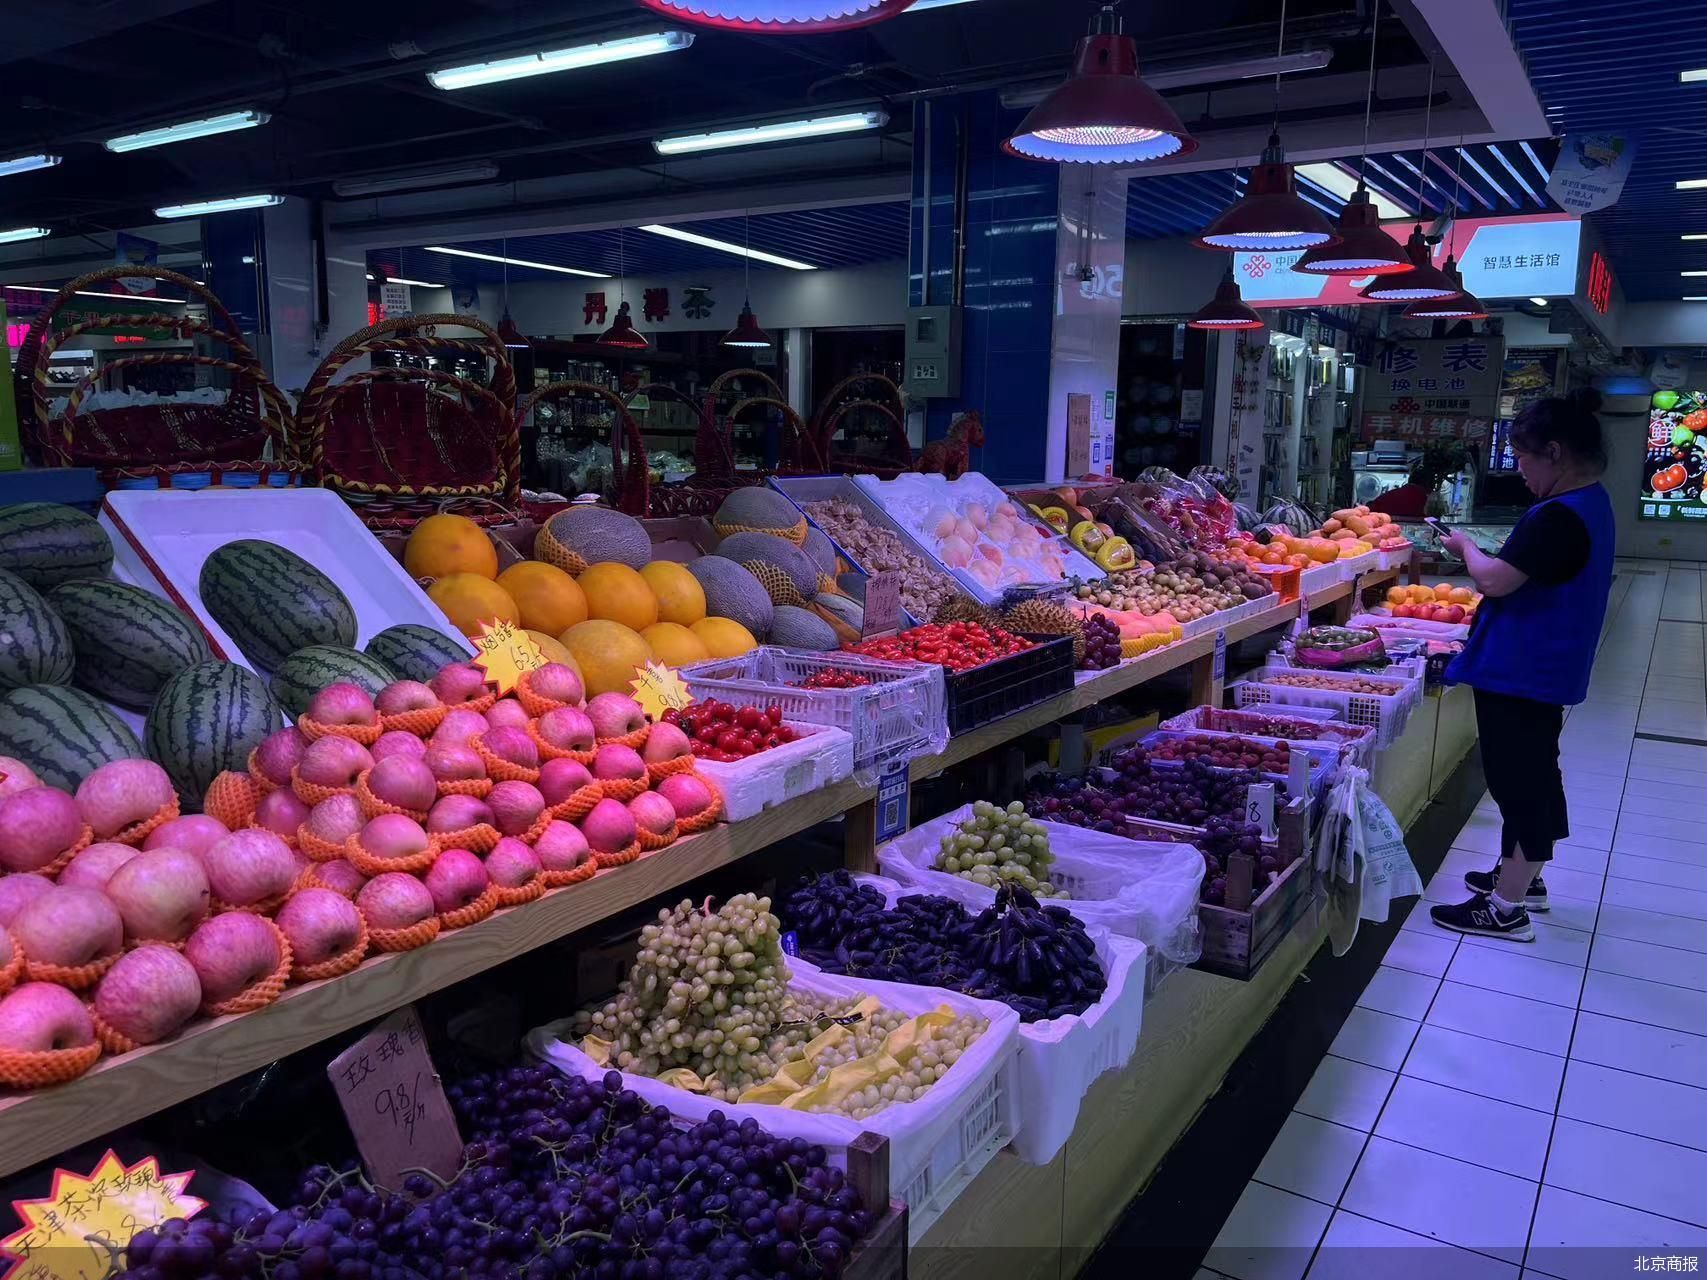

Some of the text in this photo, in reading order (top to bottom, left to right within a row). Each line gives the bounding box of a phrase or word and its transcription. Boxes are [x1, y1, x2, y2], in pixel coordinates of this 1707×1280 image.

[1483, 253, 1560, 270] 智慧生活馆
[1376, 342, 1488, 376] 修表
[1391, 378, 1465, 391] 换电池
[1424, 399, 1470, 409] 中国联通
[1368, 415, 1488, 438] 手机维修
[1248, 801, 1261, 822] 8
[1471, 910, 1493, 925] N
